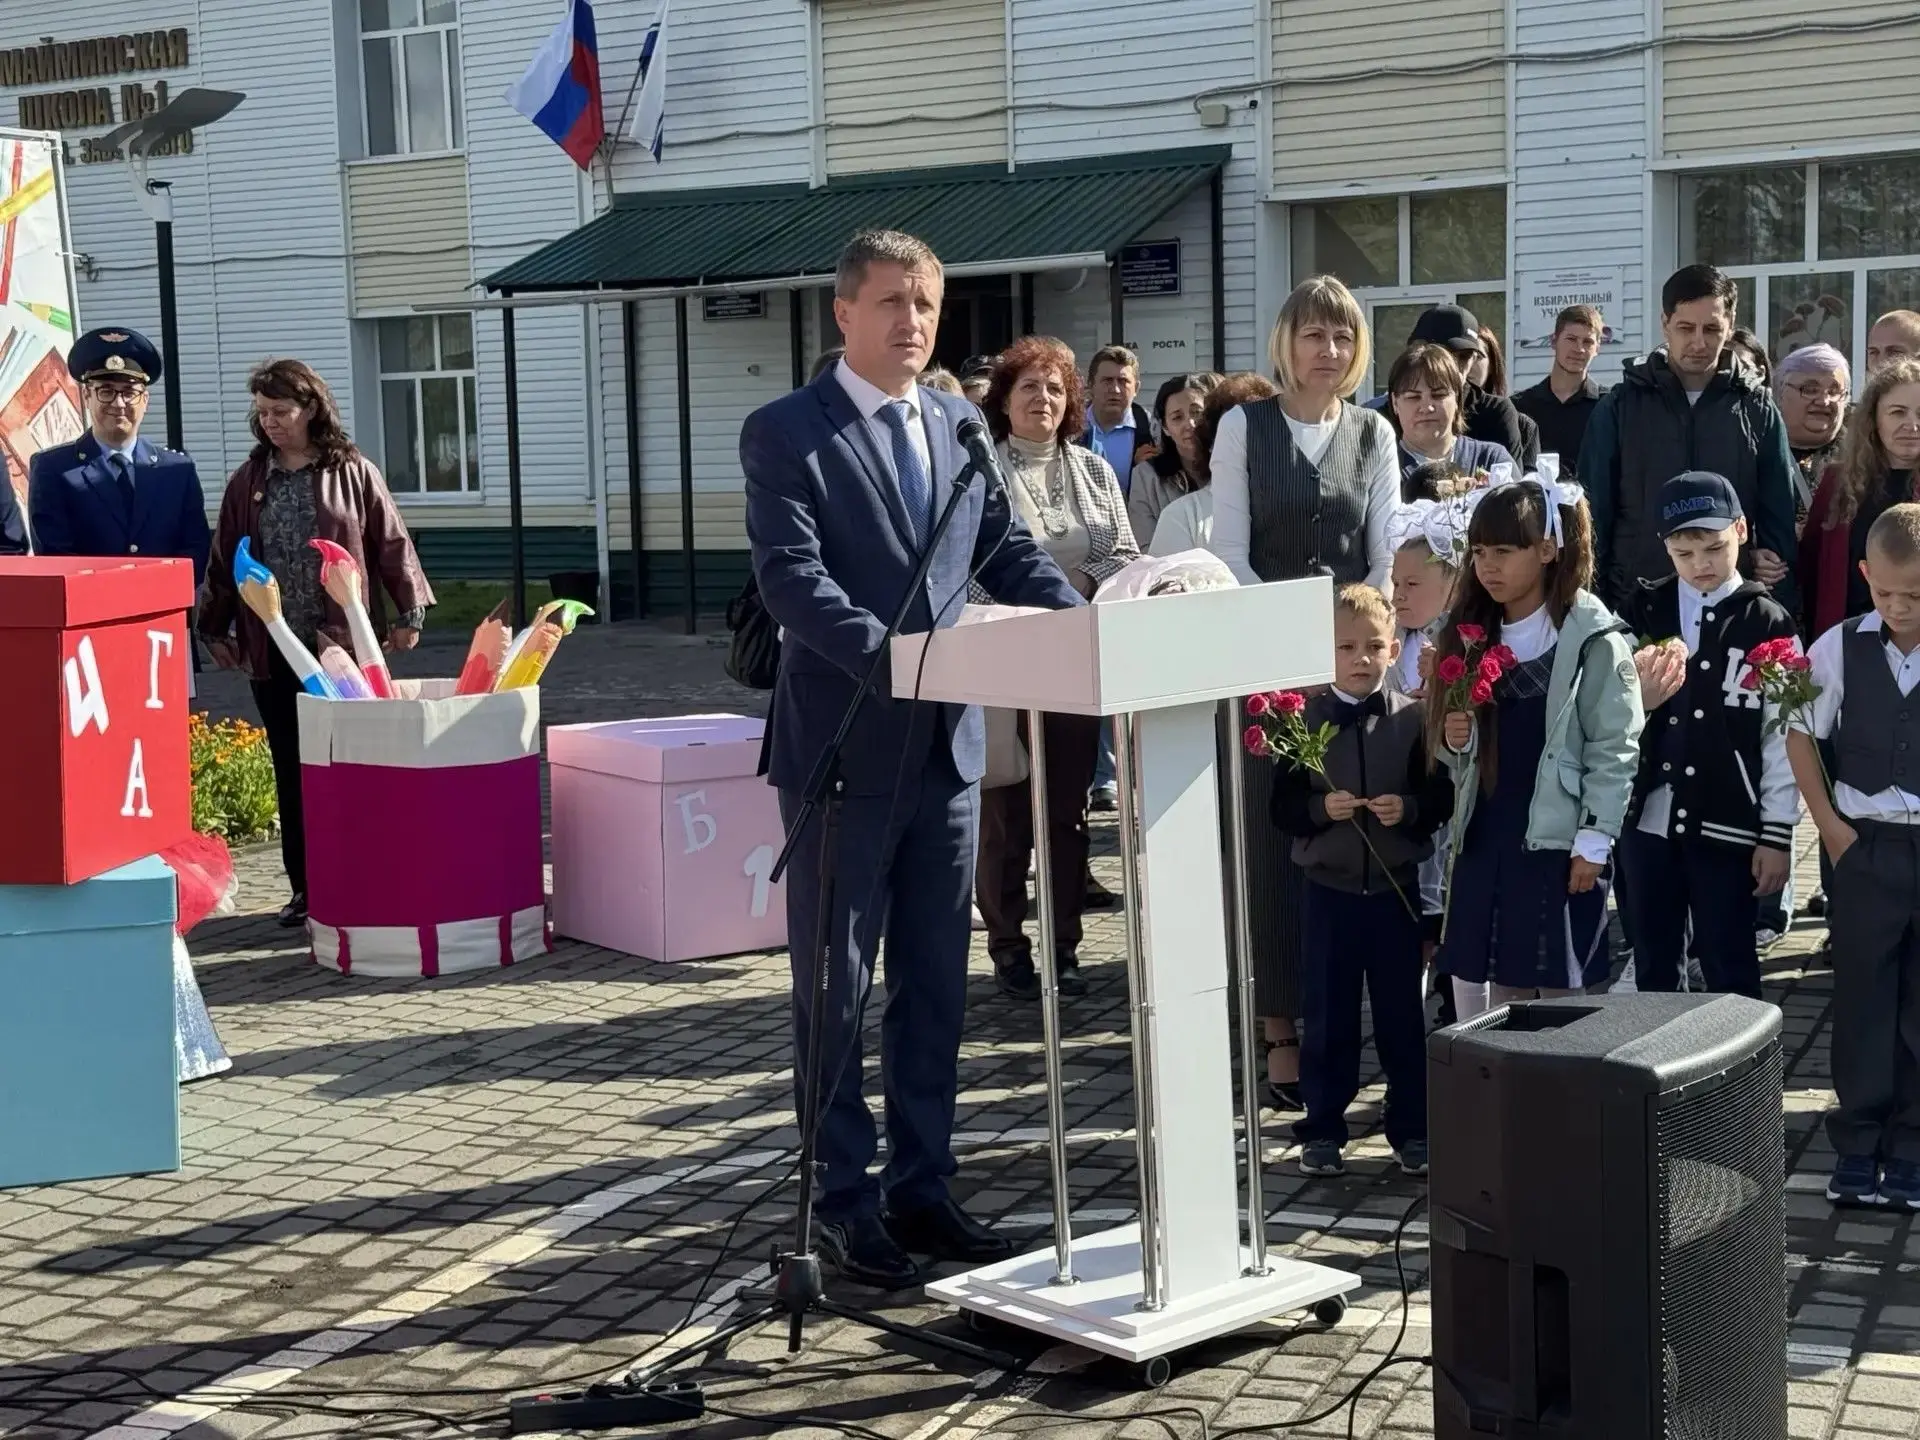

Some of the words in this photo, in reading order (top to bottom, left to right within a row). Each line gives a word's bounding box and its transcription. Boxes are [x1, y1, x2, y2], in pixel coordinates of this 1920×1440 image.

[0, 28, 188, 86] МАЙМИНСКАЯ
[18, 87, 114, 130] ШКОЛА
[1533, 291, 1612, 306] ИЗБИРАТЕЛЬНЫЙ
[1152, 340, 1185, 349] РОСТА
[120, 738, 153, 818] А
[673, 790, 717, 855] Б
[743, 844, 774, 918] 1
